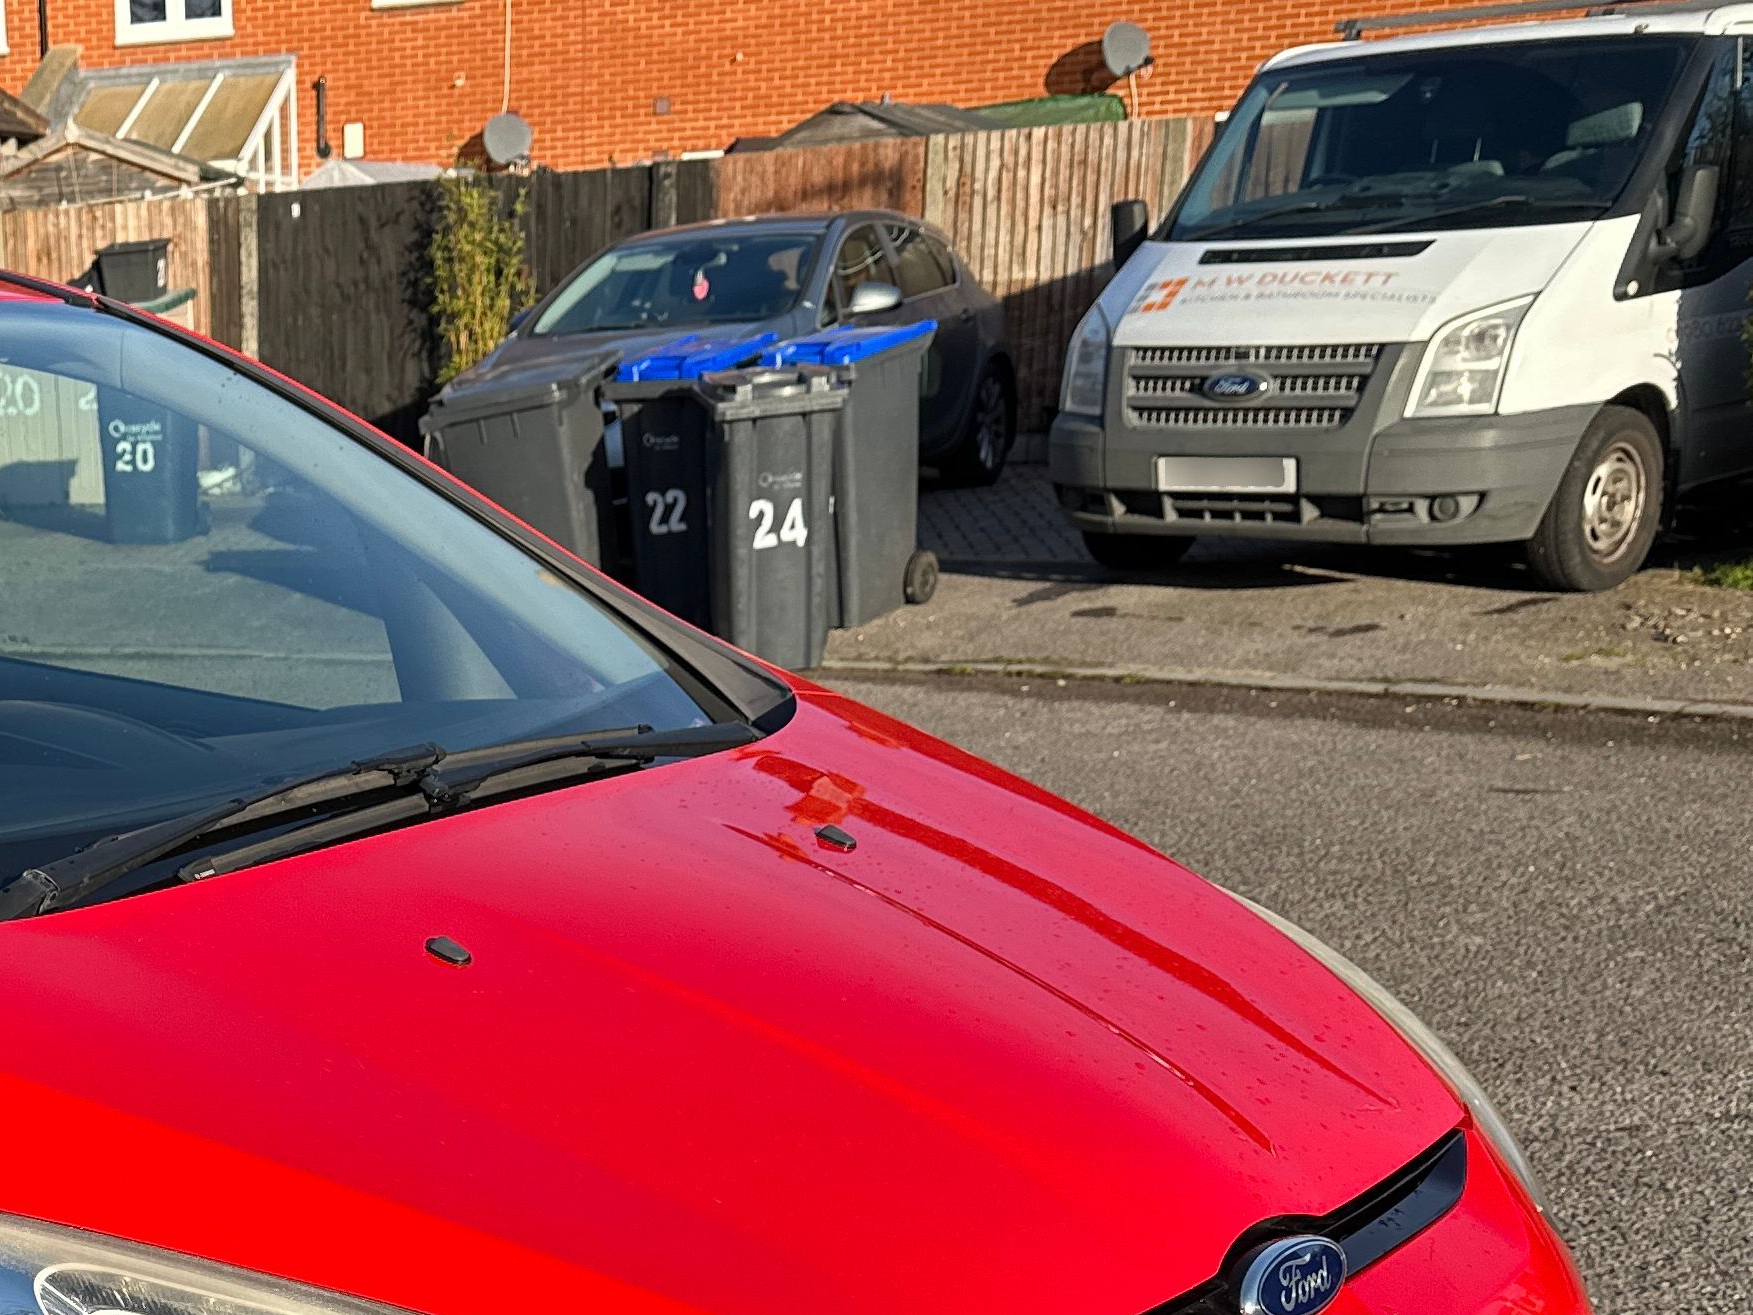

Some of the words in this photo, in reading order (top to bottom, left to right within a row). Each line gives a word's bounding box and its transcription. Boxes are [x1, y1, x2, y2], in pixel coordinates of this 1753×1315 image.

[1255, 270, 1399, 287] DUCKETT
[114, 440, 156, 472] 20
[645, 488, 688, 535] 22
[748, 497, 809, 550] 24
[1278, 1252, 1332, 1312] Ford
